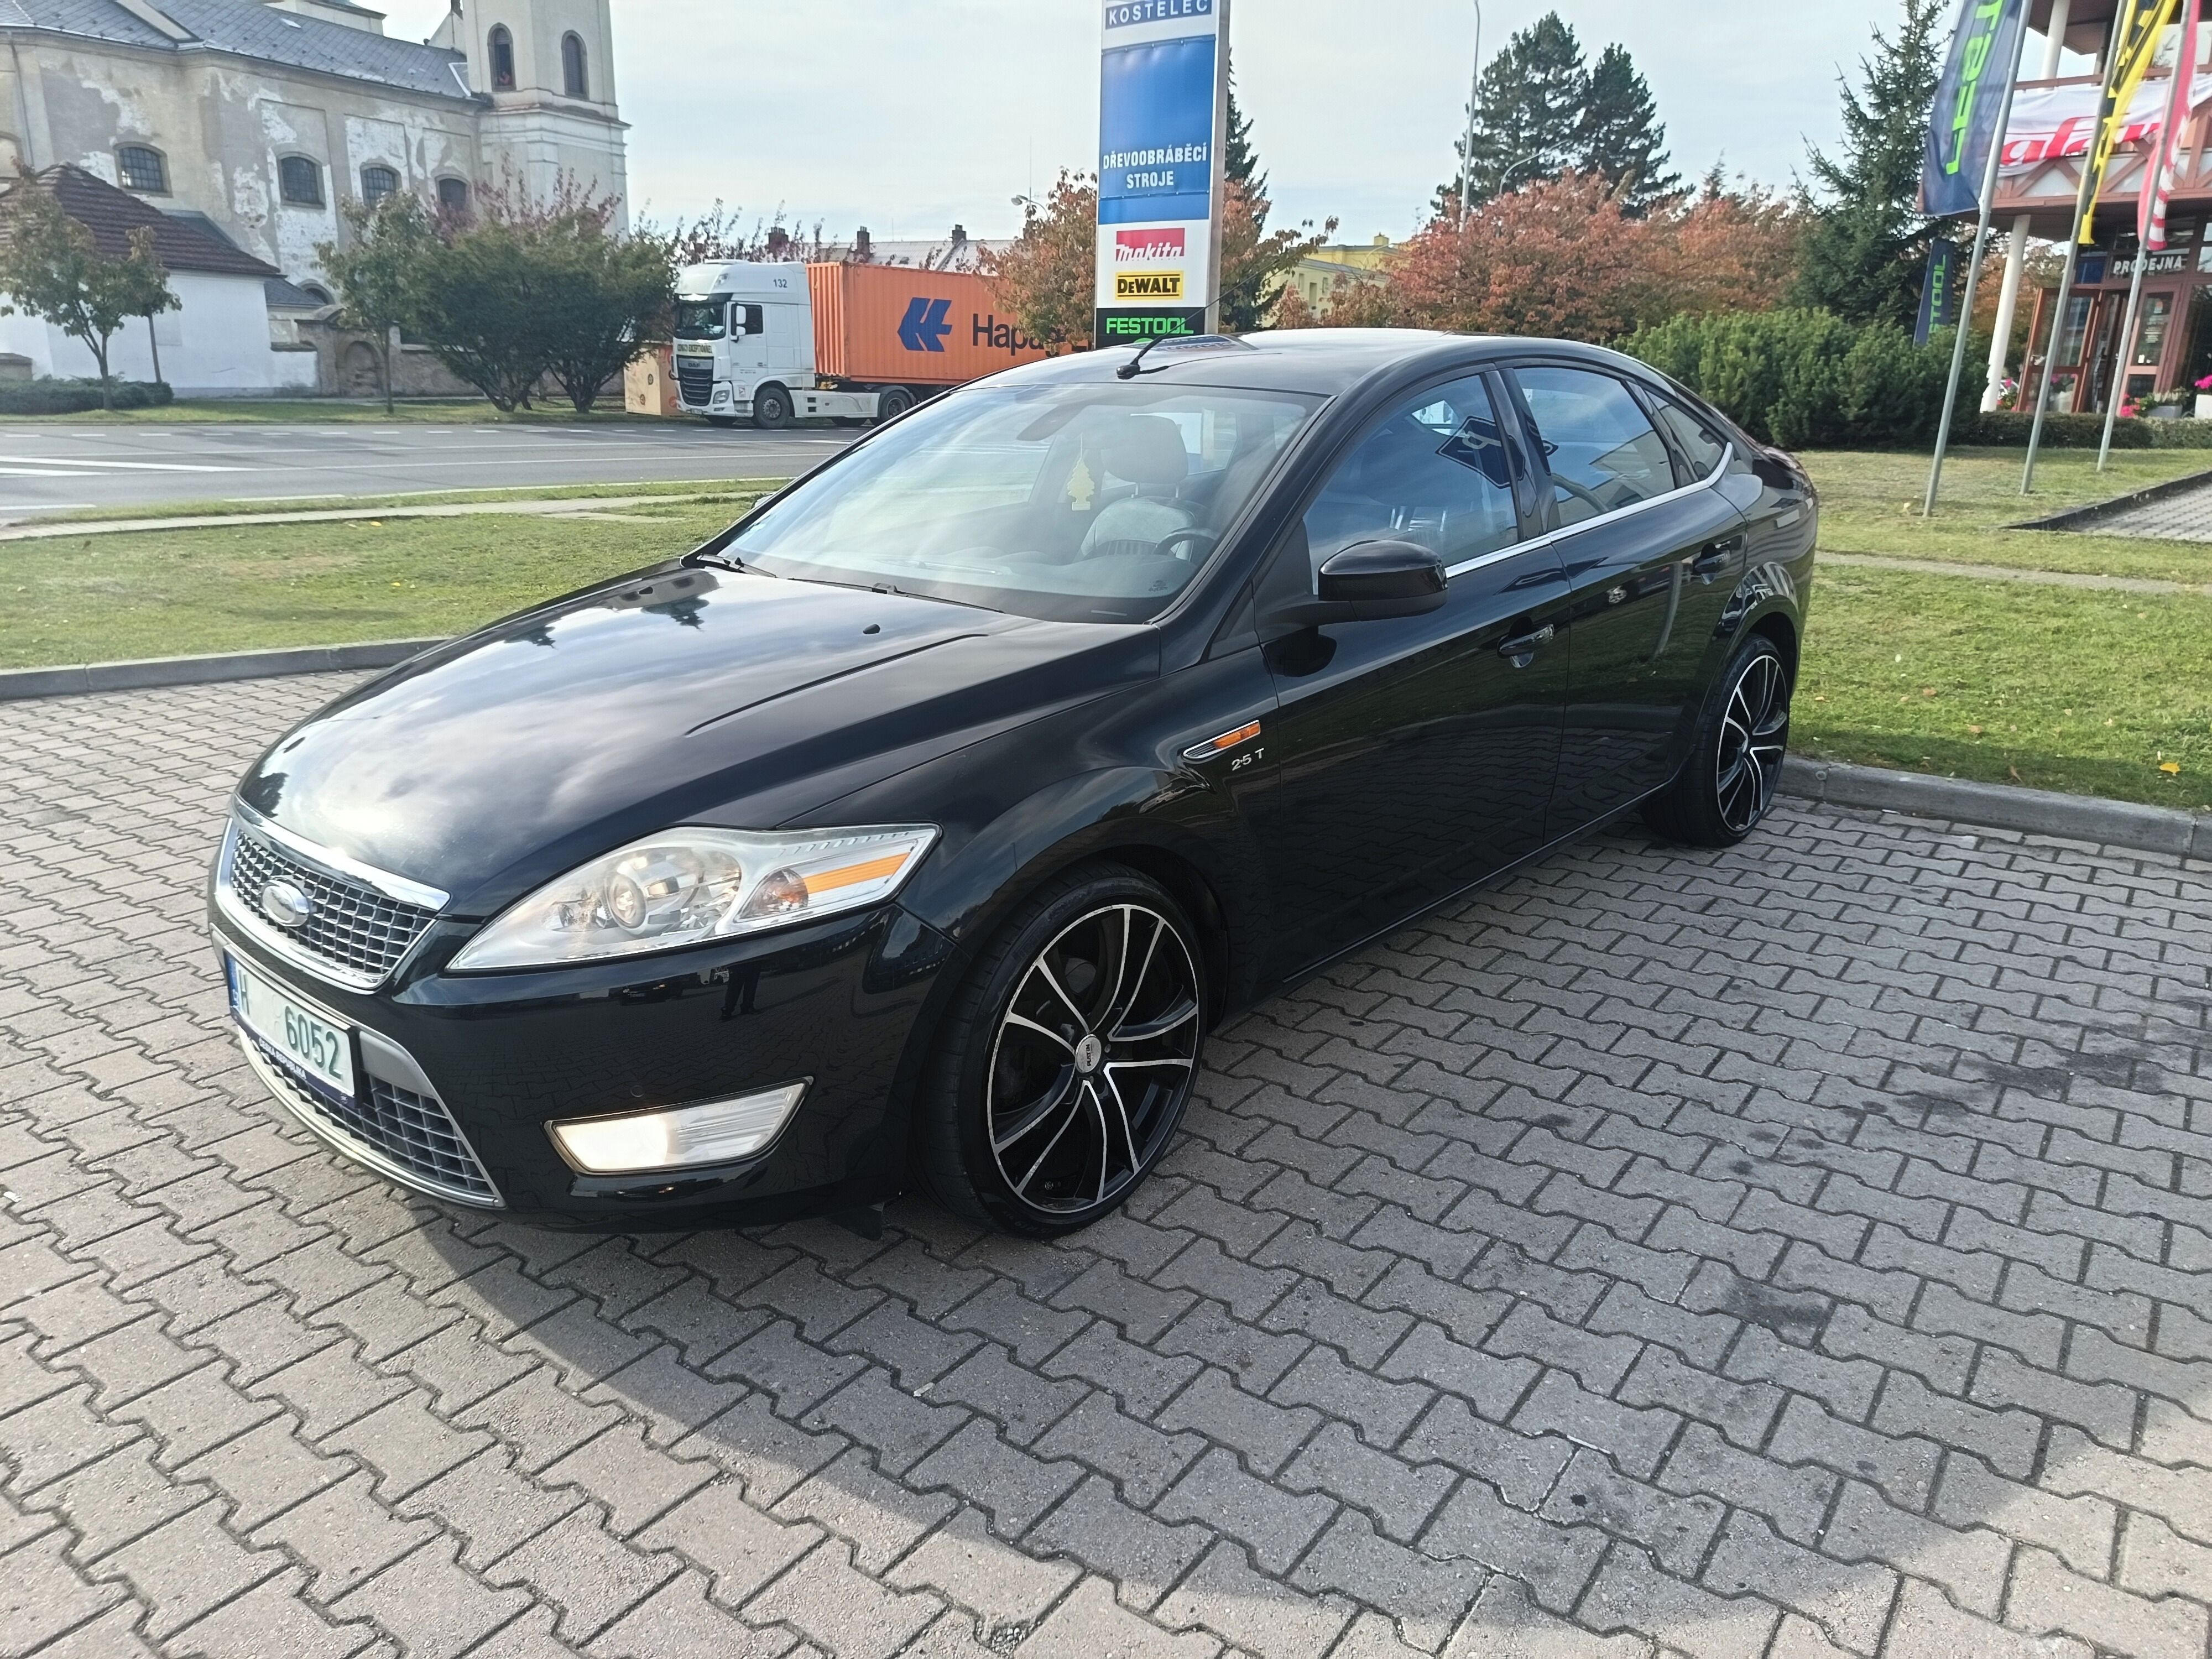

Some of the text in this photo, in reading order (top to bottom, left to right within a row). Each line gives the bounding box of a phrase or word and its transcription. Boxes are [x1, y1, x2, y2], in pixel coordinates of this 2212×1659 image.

[1109, 0, 1208, 25] KOSTELEC
[1103, 142, 1207, 170] DŘEVOOBRÁBĚCÍ
[1126, 170, 1175, 189] STROJE
[773, 278, 788, 288] 132
[1106, 317, 1194, 334] FESTOOL
[1254, 747, 1265, 759] T
[284, 1005, 343, 1080] 6052
